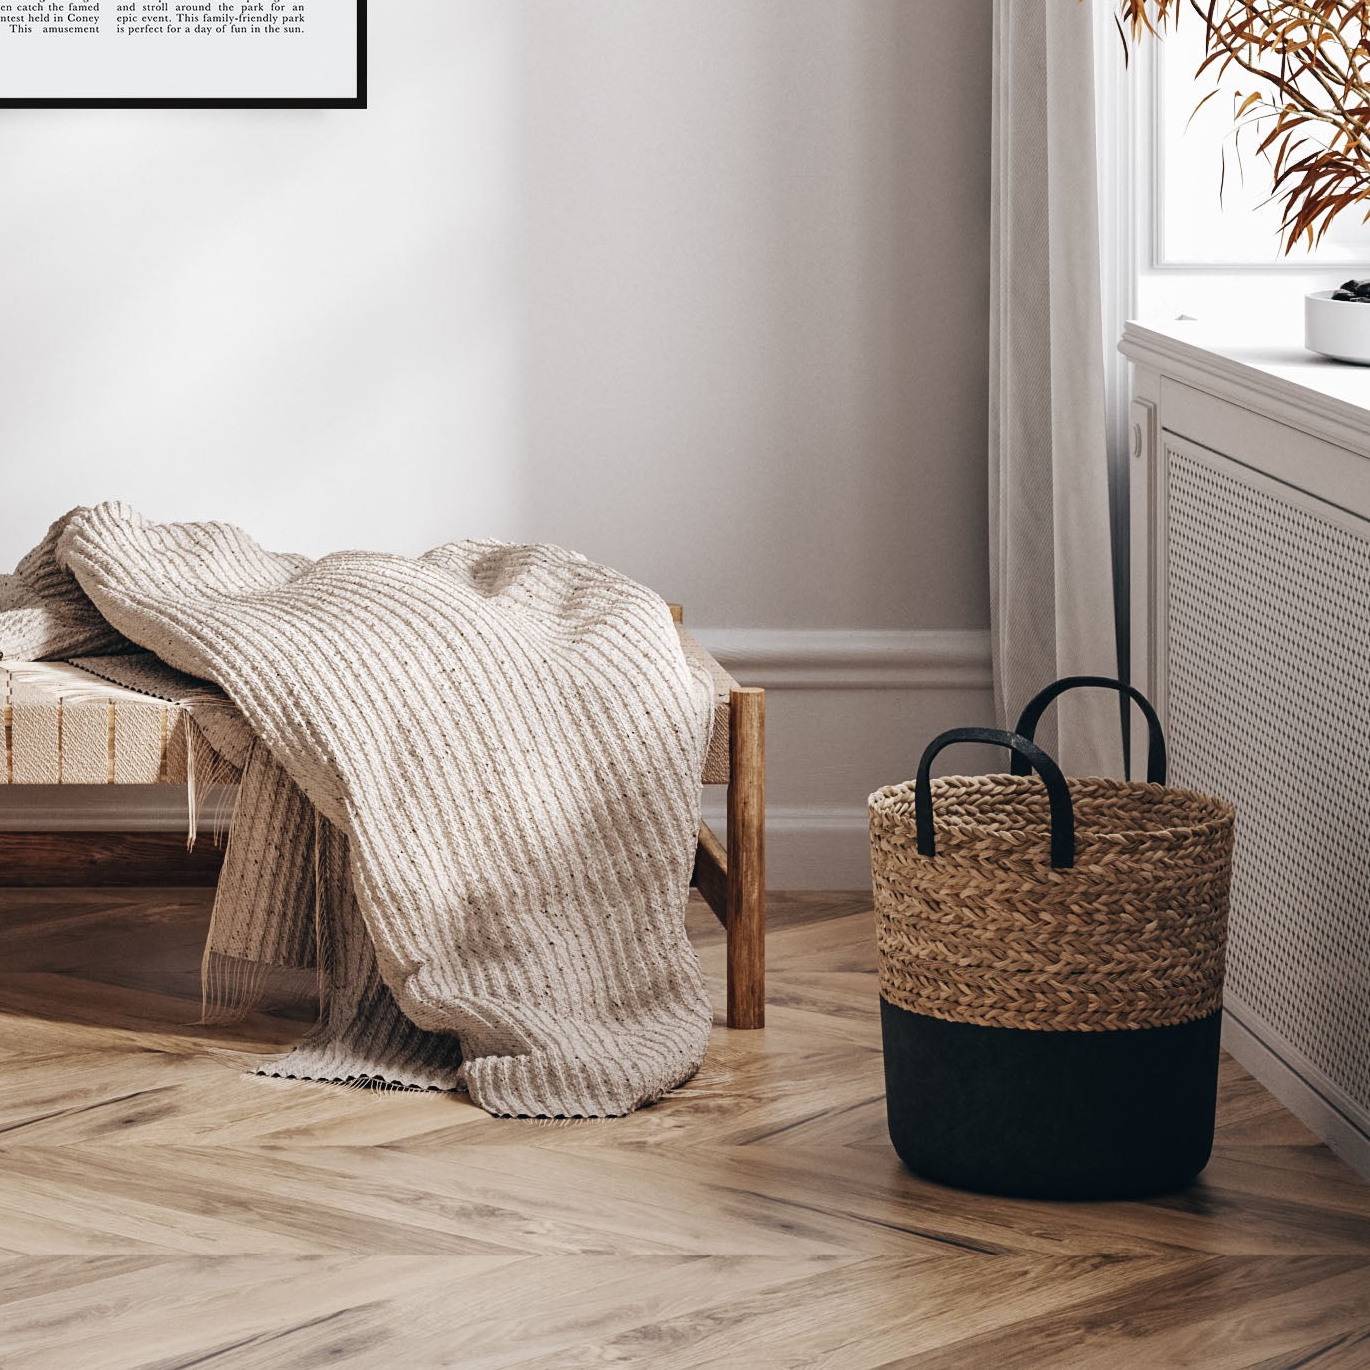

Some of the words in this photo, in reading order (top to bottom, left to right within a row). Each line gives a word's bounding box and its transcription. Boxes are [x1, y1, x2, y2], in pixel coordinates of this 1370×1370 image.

[16, 3, 44, 12] catch
[48, 3, 64, 12] the
[68, 3, 100, 12] famed
[116, 14, 138, 25] epic
[141, 14, 172, 22] event.
[176, 14, 199, 22] This
[203, 14, 279, 25] family-friendly
[282, 14, 305, 25] park
